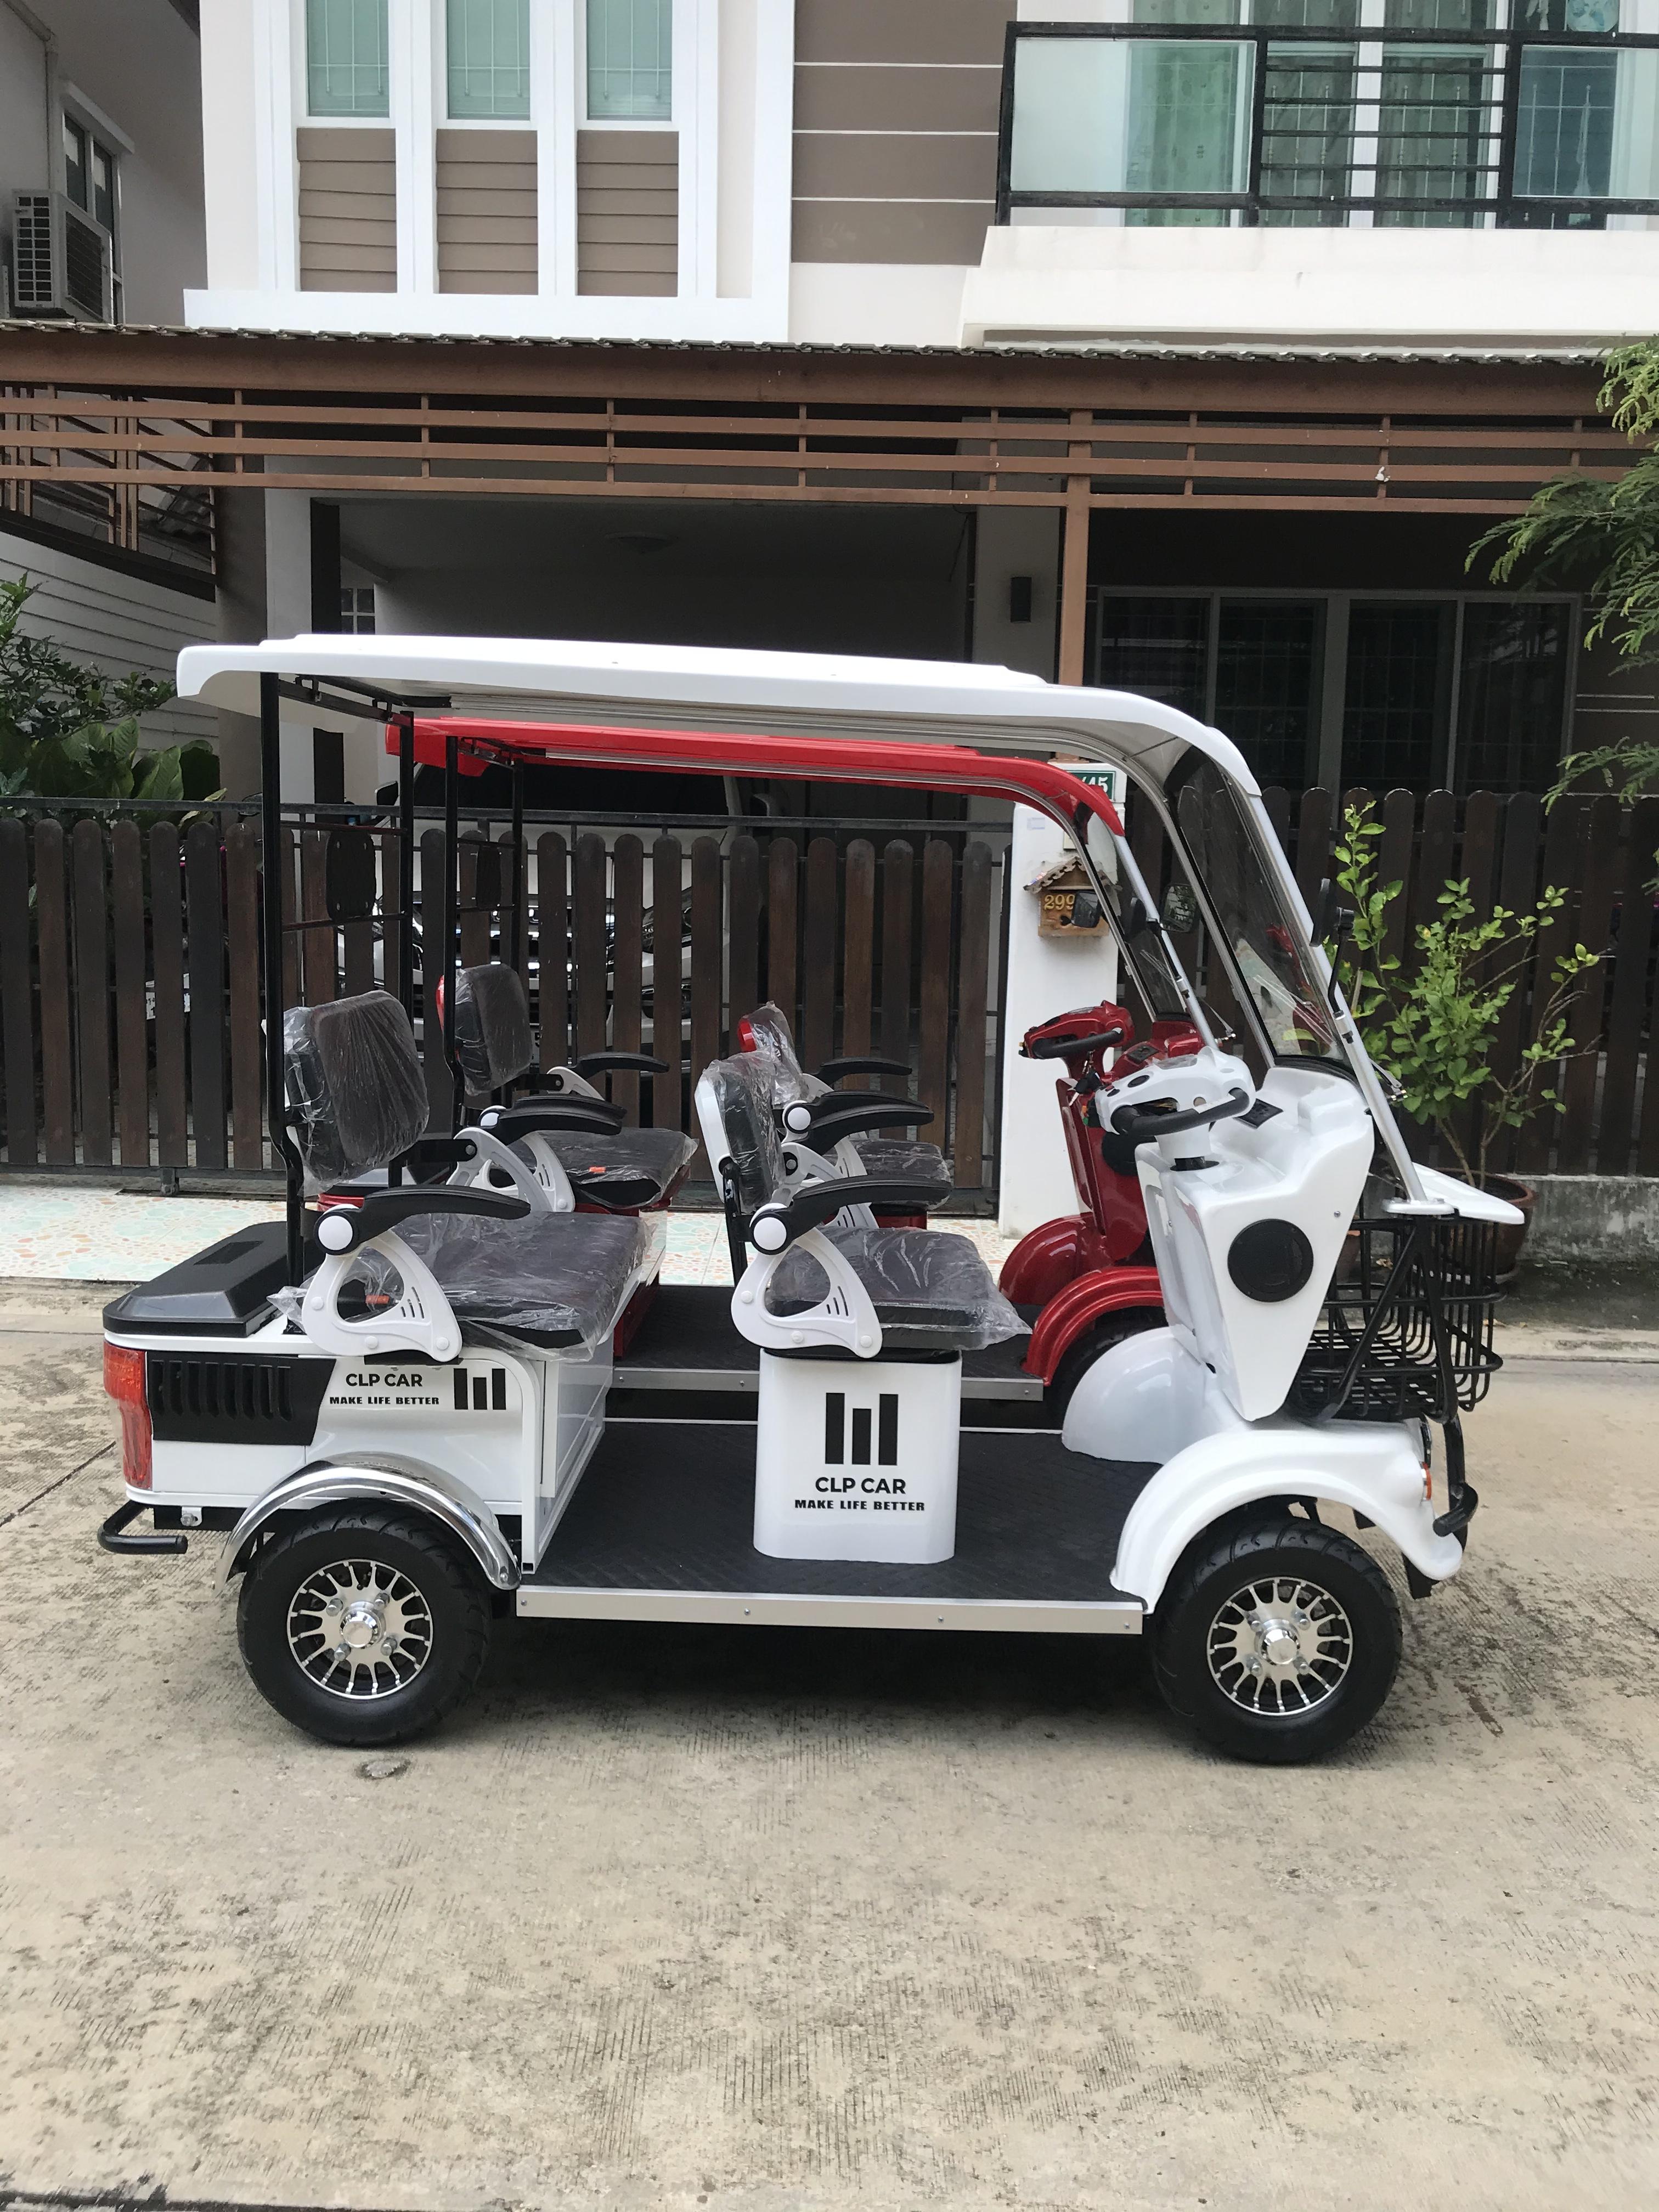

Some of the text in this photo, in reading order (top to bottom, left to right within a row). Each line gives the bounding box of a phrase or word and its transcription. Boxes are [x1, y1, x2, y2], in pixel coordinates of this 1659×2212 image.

[1044, 894, 1075, 910] 299
[346, 1373, 422, 1387] CLP CAR
[368, 1396, 391, 1404] LIFE
[396, 1397, 439, 1405] BETTER
[815, 1477, 906, 1494] CLP CAR
[795, 1499, 924, 1511] MAKE LIFE BETTER
